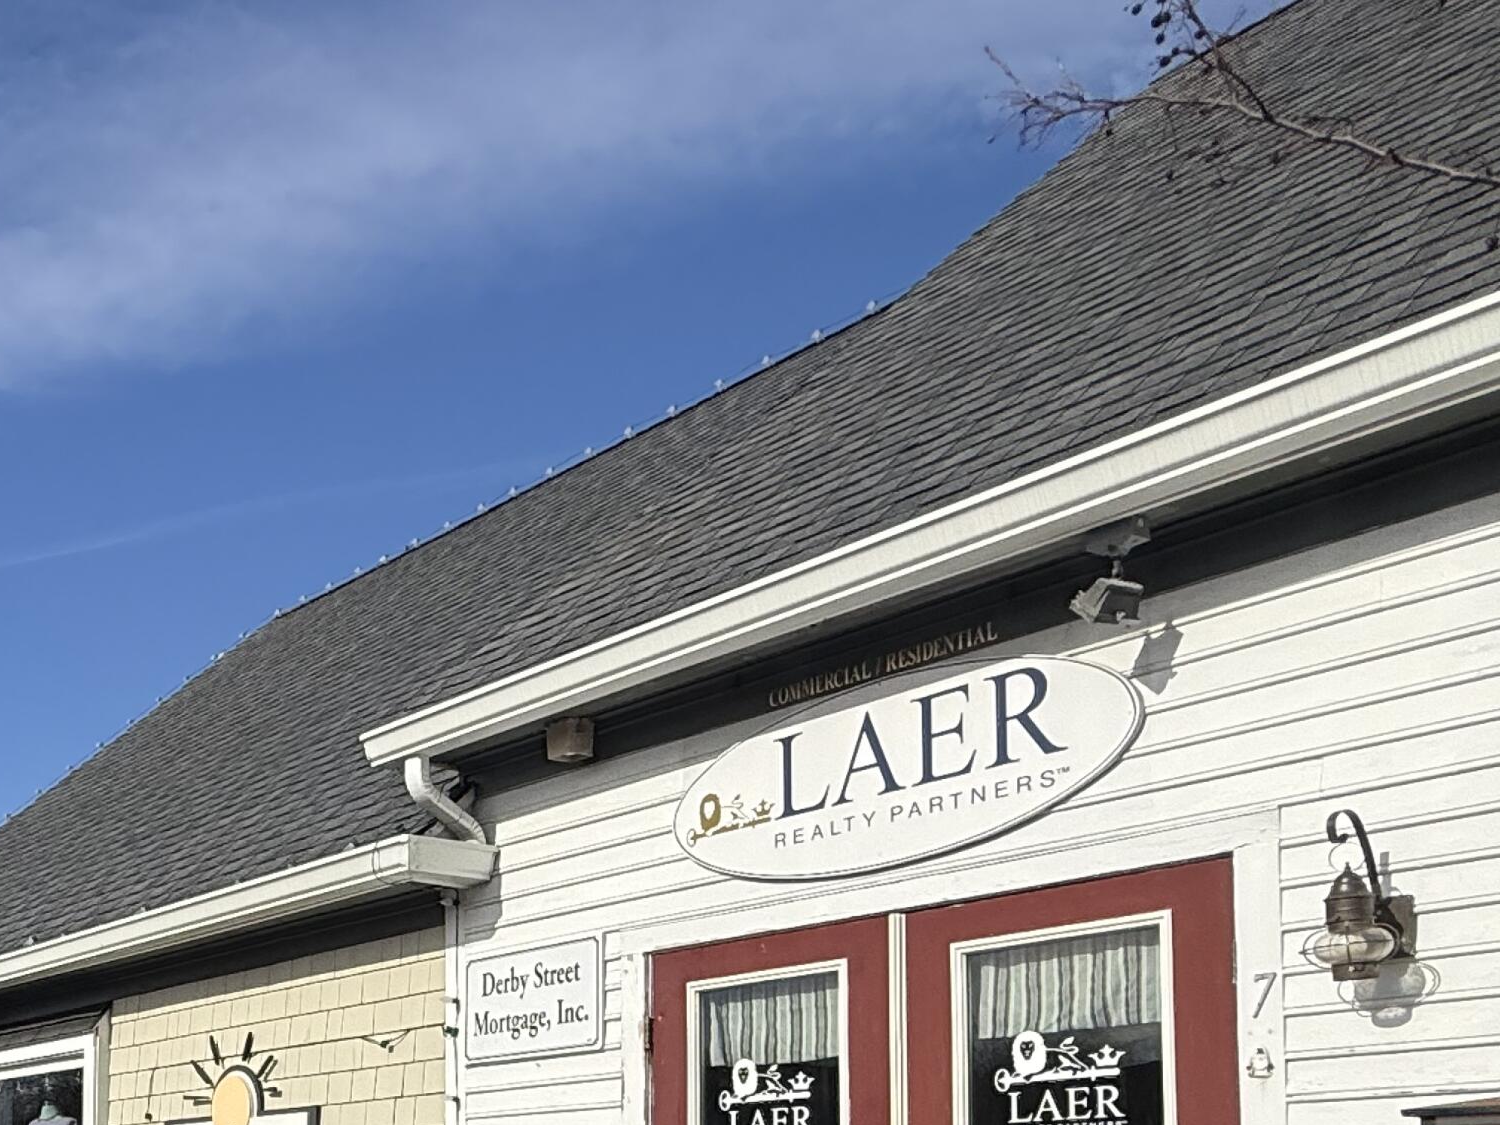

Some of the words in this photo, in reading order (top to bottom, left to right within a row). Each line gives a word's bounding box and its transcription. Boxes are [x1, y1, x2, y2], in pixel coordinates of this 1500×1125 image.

[769, 660, 872, 708] COMMERCIAL
[884, 621, 998, 674] RESIDENTIAL
[773, 666, 1069, 821] LAER
[774, 811, 876, 849] REALTY
[481, 966, 530, 1000] Derby
[533, 961, 581, 989] Street
[1252, 972, 1277, 1019] 7
[473, 1010, 551, 1040] Mortgage,
[557, 999, 589, 1025] Inc.
[1007, 1085, 1126, 1124] LAER
